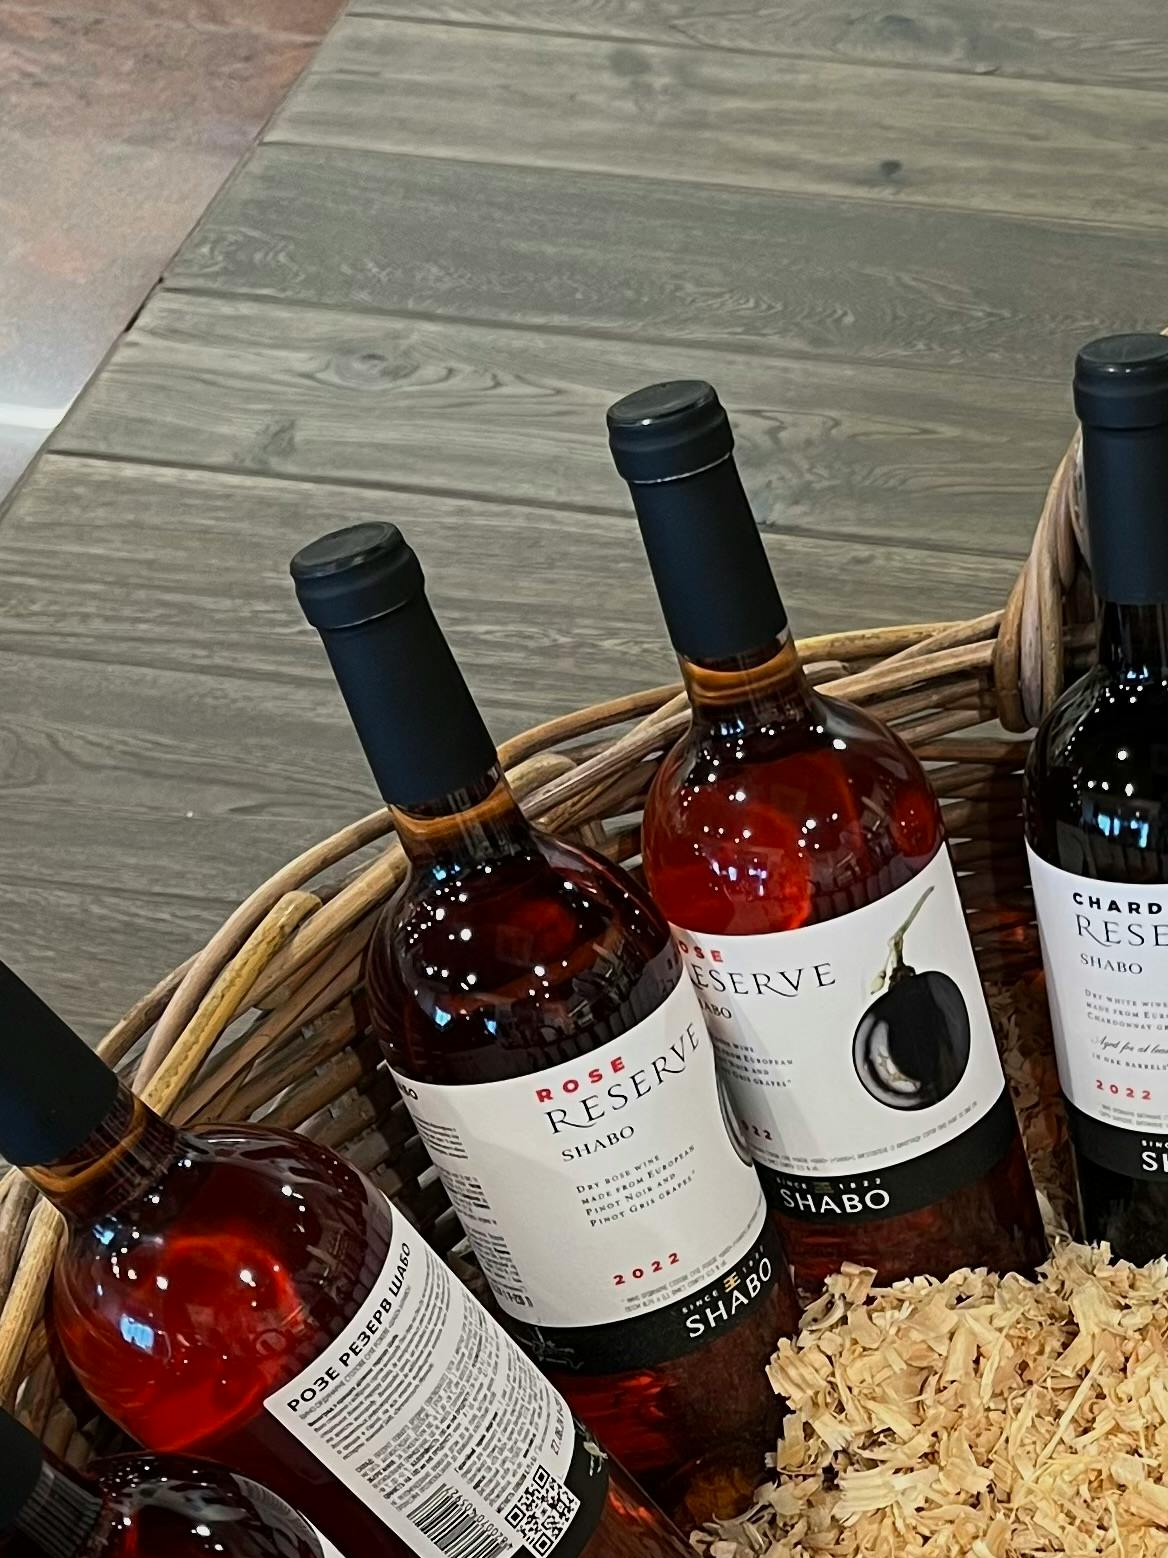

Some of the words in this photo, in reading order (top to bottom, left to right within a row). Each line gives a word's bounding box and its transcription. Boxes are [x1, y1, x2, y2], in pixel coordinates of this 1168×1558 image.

[678, 940, 724, 963] OSE
[1080, 953, 1143, 975] SHABO
[690, 962, 837, 998] ESERVE
[700, 998, 732, 1020] ABO
[536, 1056, 625, 1102] ROSE
[544, 1022, 700, 1135] RESERVE
[1096, 1079, 1152, 1100] 2022
[561, 1125, 635, 1162] SHABO
[576, 1182, 599, 1193] DRY
[634, 1155, 659, 1171] WINE
[581, 1191, 612, 1205] MADE
[616, 1177, 644, 1193] FROM
[647, 1144, 695, 1179] EUROPEAN
[585, 1200, 621, 1216] PINOT
[625, 1187, 652, 1202] NOIR
[658, 1173, 675, 1187] AND
[590, 1211, 625, 1227] PINOT
[629, 1198, 655, 1213] GRIS
[780, 1189, 890, 1214] SHABO
[613, 1252, 680, 1285] 2022
[682, 1289, 719, 1314] SINCE
[685, 1258, 772, 1338] SHABO
[287, 1367, 341, 1412] РОЗЕ
[339, 1298, 392, 1368] РЕЗЕРВ
[388, 1242, 411, 1297] ШАБО
